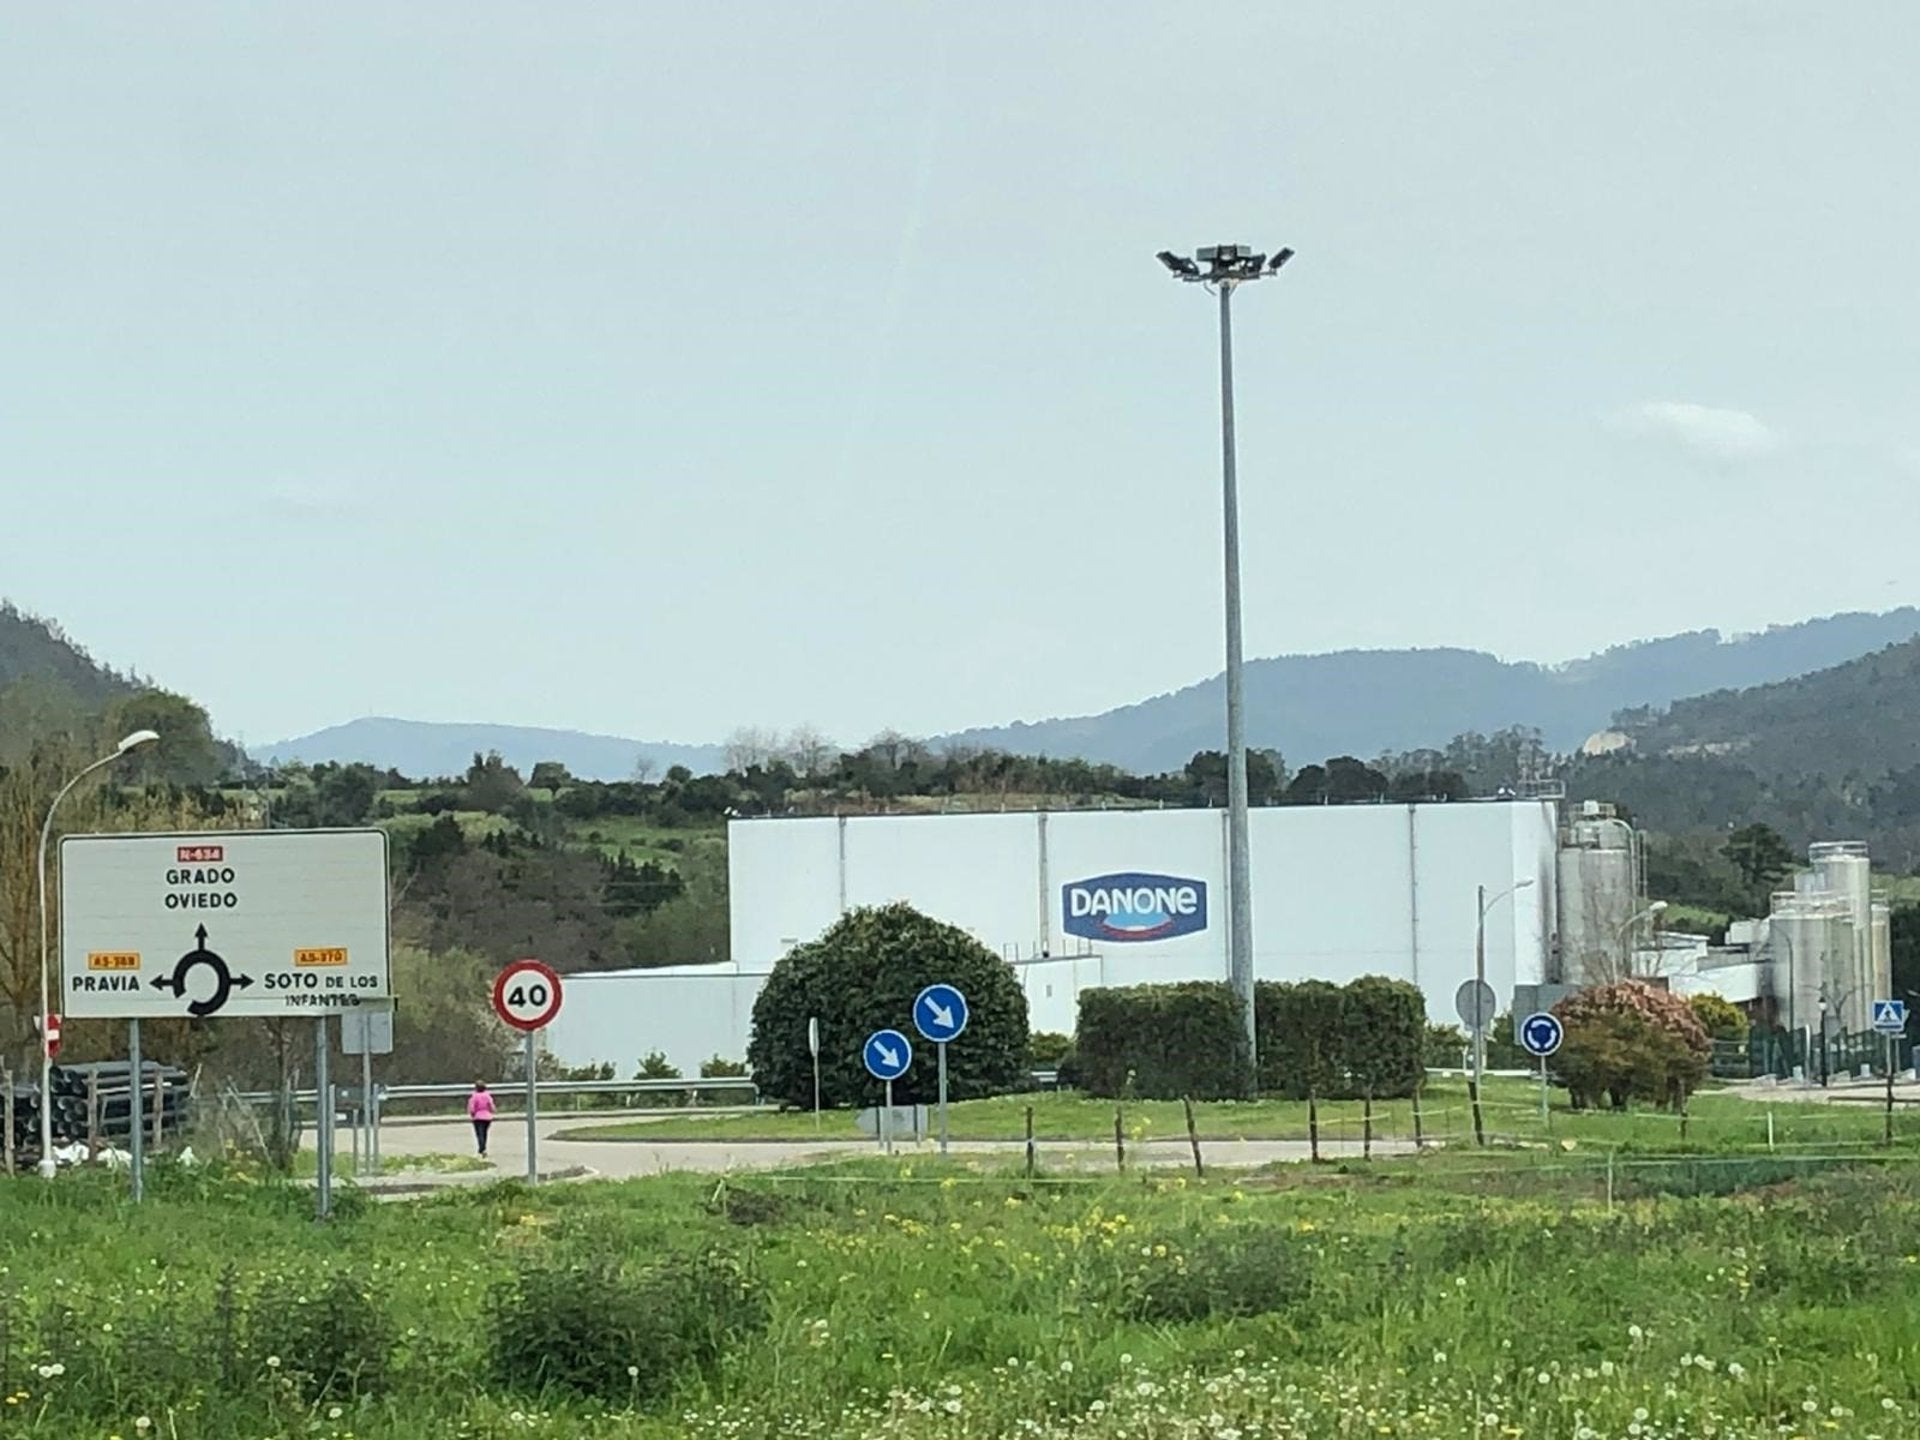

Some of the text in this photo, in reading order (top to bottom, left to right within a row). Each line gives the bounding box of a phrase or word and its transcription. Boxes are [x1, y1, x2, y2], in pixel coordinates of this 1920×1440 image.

[166, 868, 235, 885] GRADO
[165, 892, 238, 909] OVIEDO
[72, 975, 140, 992] PRAVIA
[264, 972, 378, 989] SOTO DE LOS
[508, 984, 547, 1008] 40
